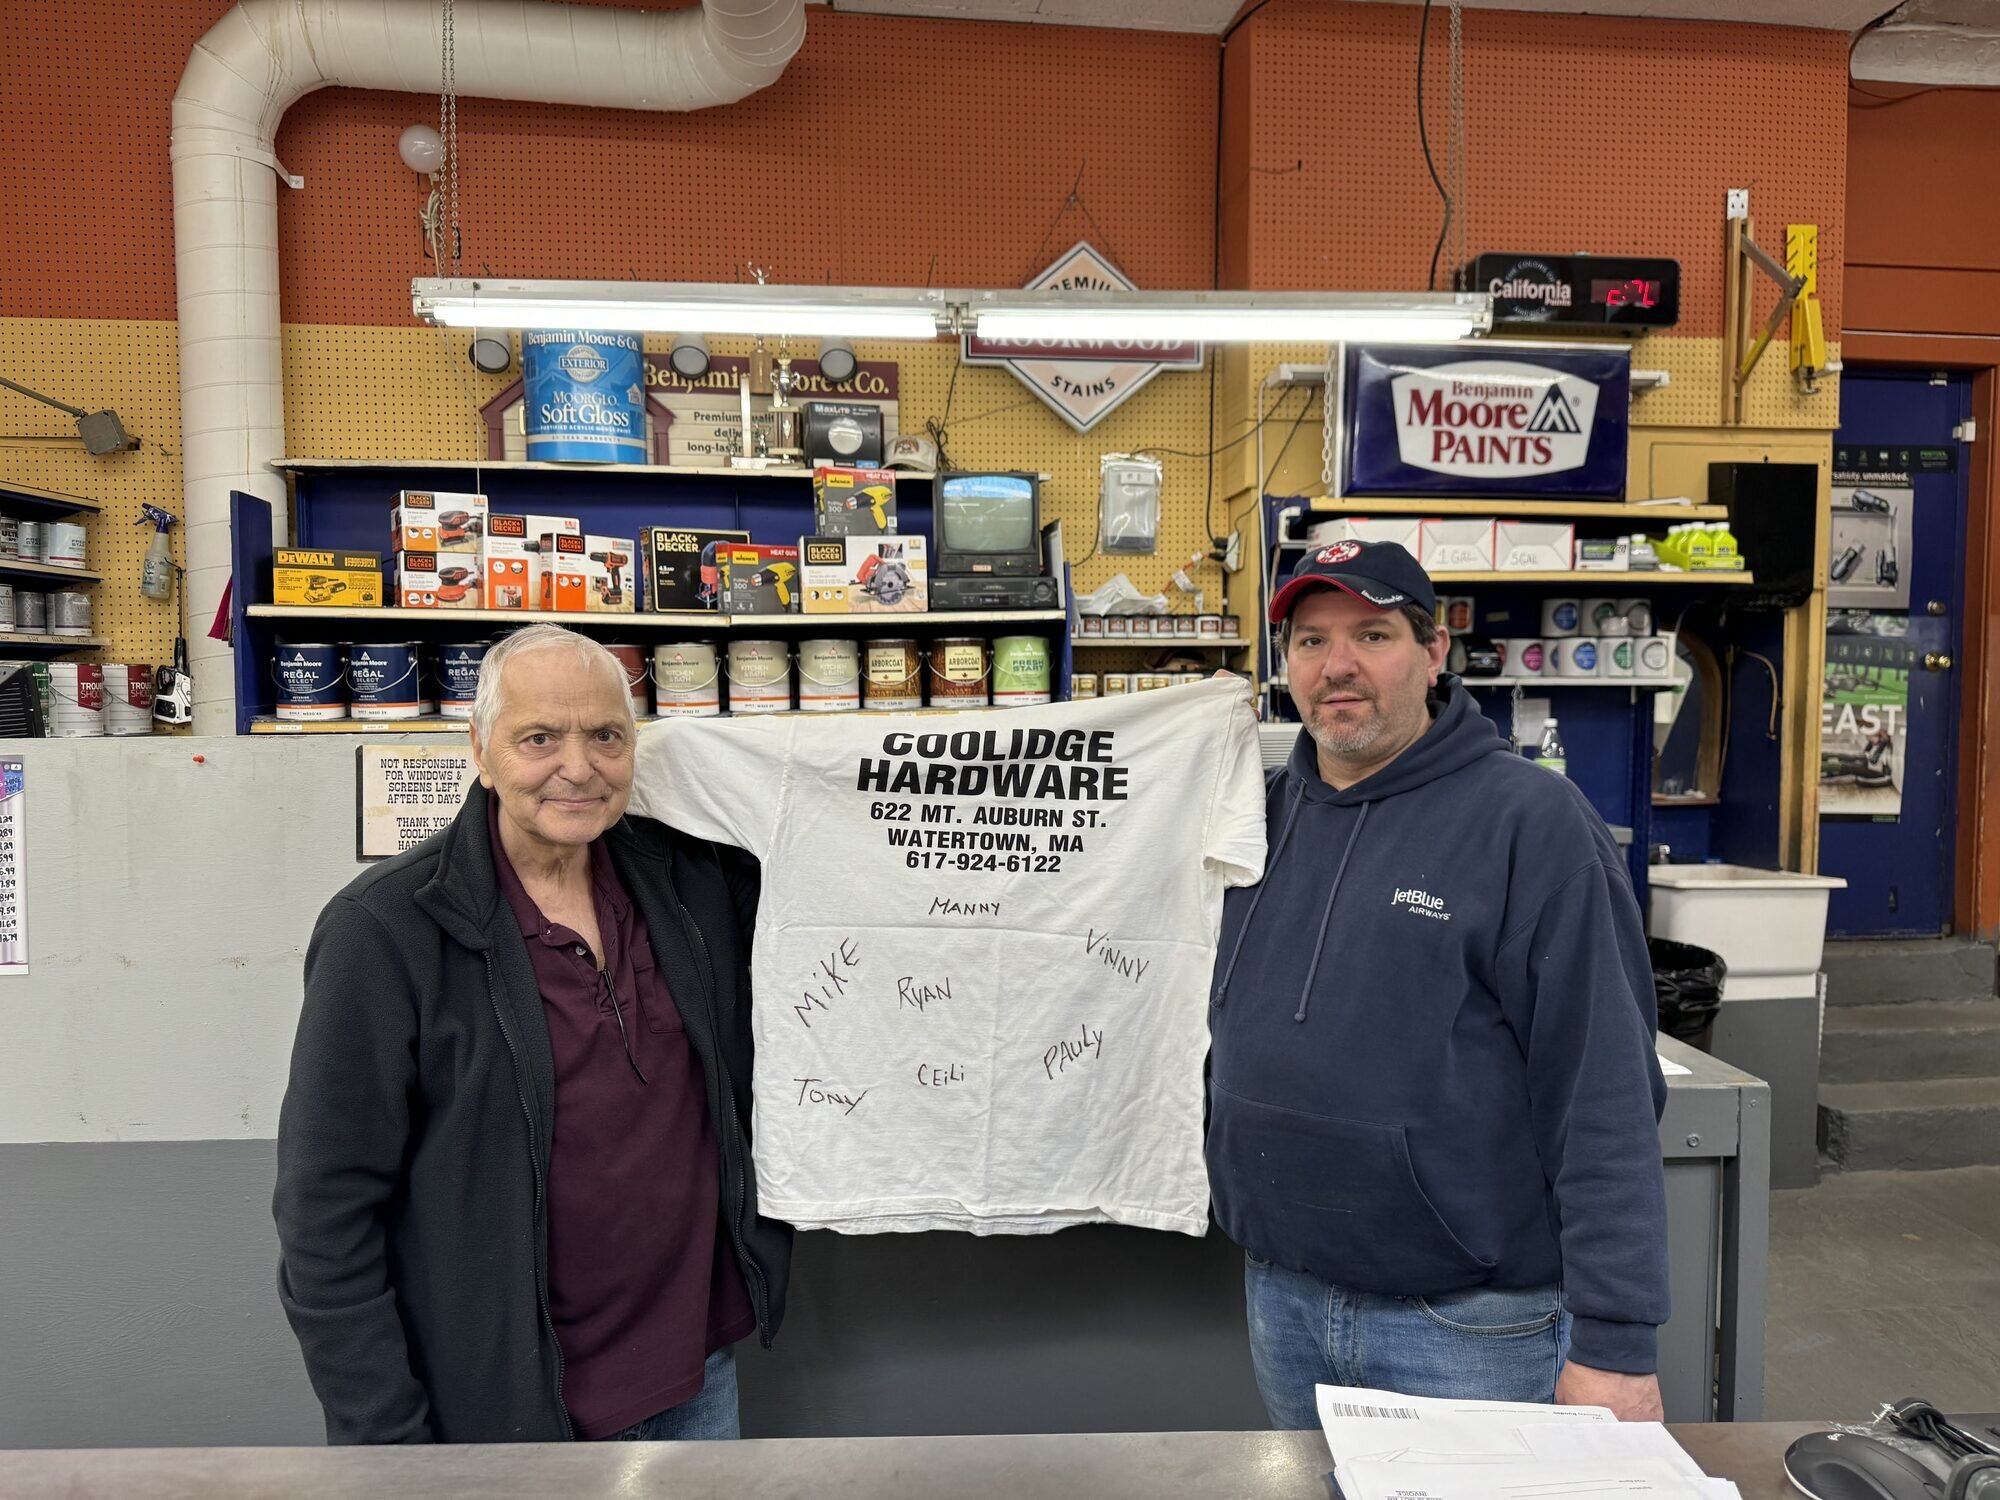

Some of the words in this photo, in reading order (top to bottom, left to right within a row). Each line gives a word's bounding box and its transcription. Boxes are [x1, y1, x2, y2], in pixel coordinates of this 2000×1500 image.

[1489, 278, 1571, 299] California
[528, 330, 575, 347] Benjamin
[578, 330, 615, 345] Moore
[561, 358, 606, 369] EXTERIOR
[1052, 376, 1115, 397] STAINS
[1452, 381, 1534, 401] Benjamin
[542, 403, 576, 423] Soft
[579, 404, 629, 427] Gloss
[1407, 389, 1528, 429] Moore
[694, 412, 741, 422] Premium
[1432, 431, 1552, 465] PAINTS
[656, 533, 698, 543] BLACK+
[657, 542, 699, 553] DECKER
[872, 659, 903, 667] ARBORCOAT
[949, 657, 980, 665] ARBORCOAT
[353, 670, 384, 678] REGAL
[882, 729, 1114, 763] COOLIDGE
[380, 759, 399, 769] NOT
[403, 759, 466, 769] RESPONSIBLE
[385, 770, 404, 780] FOR
[407, 771, 453, 780] WINDOWS
[456, 771, 462, 780] &
[857, 758, 1128, 800] HARDWARE
[389, 782, 432, 792] SCREENS
[436, 782, 460, 792] LEFT
[387, 794, 418, 804] AFTER
[421, 794, 434, 804] 30
[437, 794, 461, 804] DAYS
[396, 817, 429, 827] THANK
[433, 818, 453, 827] YOU
[870, 802, 912, 821] 622
[921, 804, 962, 823] MT.
[973, 807, 1064, 827] AUBURN
[1072, 810, 1107, 828] ST.
[888, 828, 1037, 855] WATERTOWN,
[1049, 835, 1084, 852] MA
[906, 851, 1061, 872] 617-924-6122
[929, 897, 1000, 915] MANNY
[1408, 906, 1451, 920] AIRWAYS
